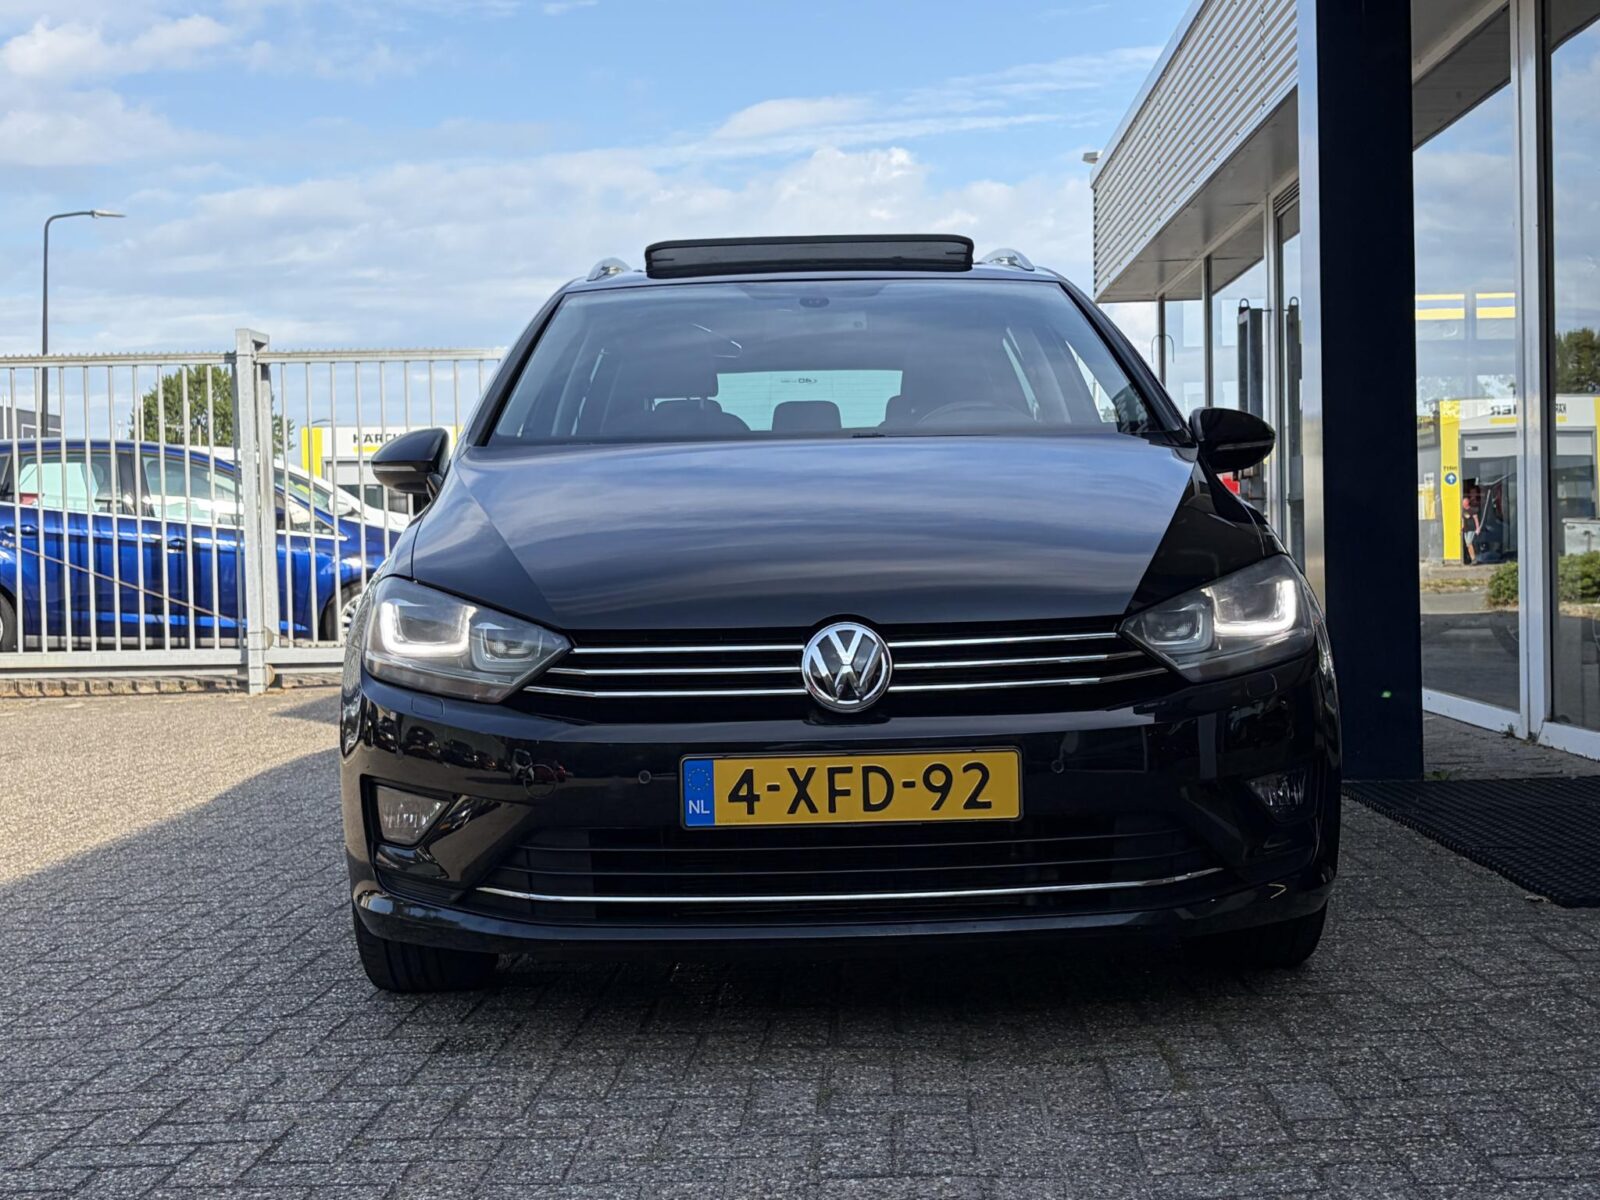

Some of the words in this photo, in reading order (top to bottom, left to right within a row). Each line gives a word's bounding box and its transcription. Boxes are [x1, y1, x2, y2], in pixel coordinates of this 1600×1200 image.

[805, 625, 888, 707] VW
[688, 800, 710, 815] NL
[727, 761, 993, 816] 4-XFD-92
